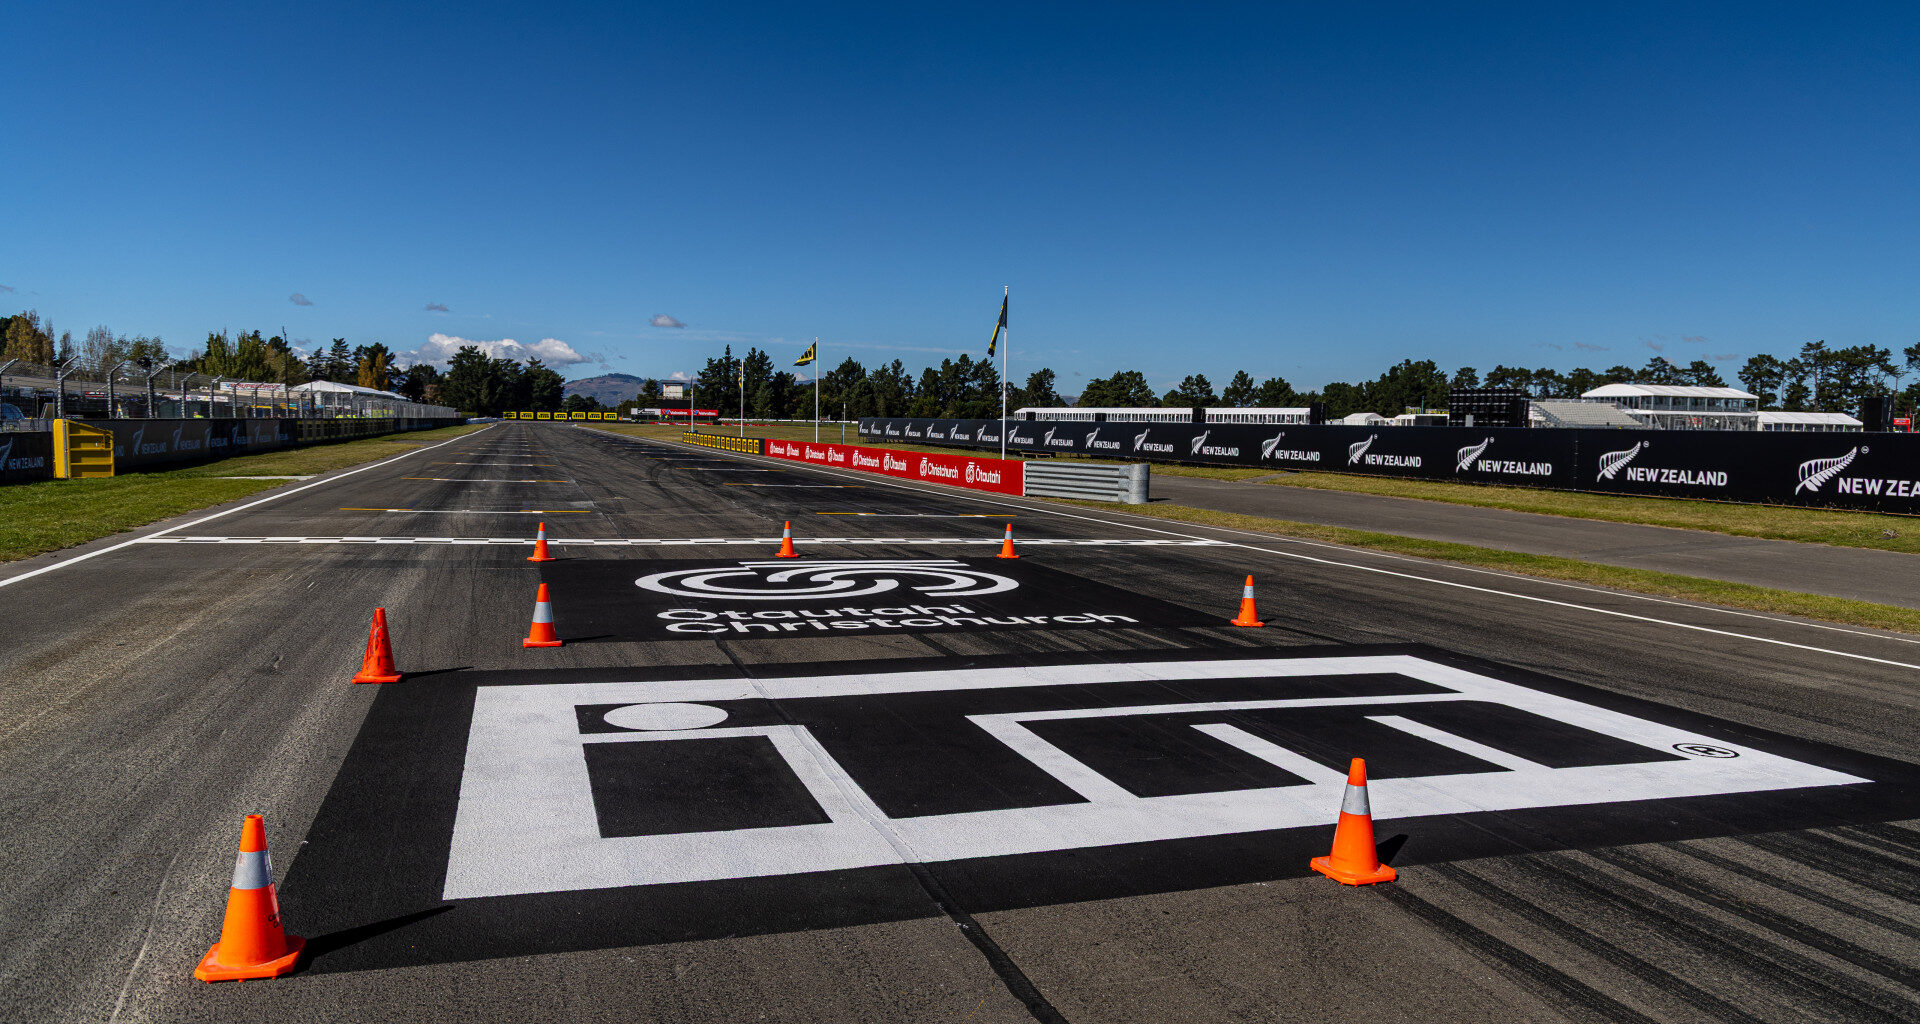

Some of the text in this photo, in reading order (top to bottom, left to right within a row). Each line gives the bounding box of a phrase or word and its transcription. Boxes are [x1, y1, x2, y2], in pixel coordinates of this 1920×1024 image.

[1094, 440, 1120, 450] NEW ZEALAND
[1143, 442, 1173, 453] NEW ZEALAND
[1202, 446, 1239, 457] NEW ZEALAND
[1275, 449, 1320, 462] NEW ZEALAND
[1365, 453, 1422, 468] NEW ZEALAND
[928, 462, 958, 479] Christchurch
[1478, 459, 1552, 476] NEW ZEALAND
[1626, 466, 1727, 486] NEW ZEALAND
[1838, 477, 1883, 496] NEW
[665, 612, 1139, 634] Christchurch
